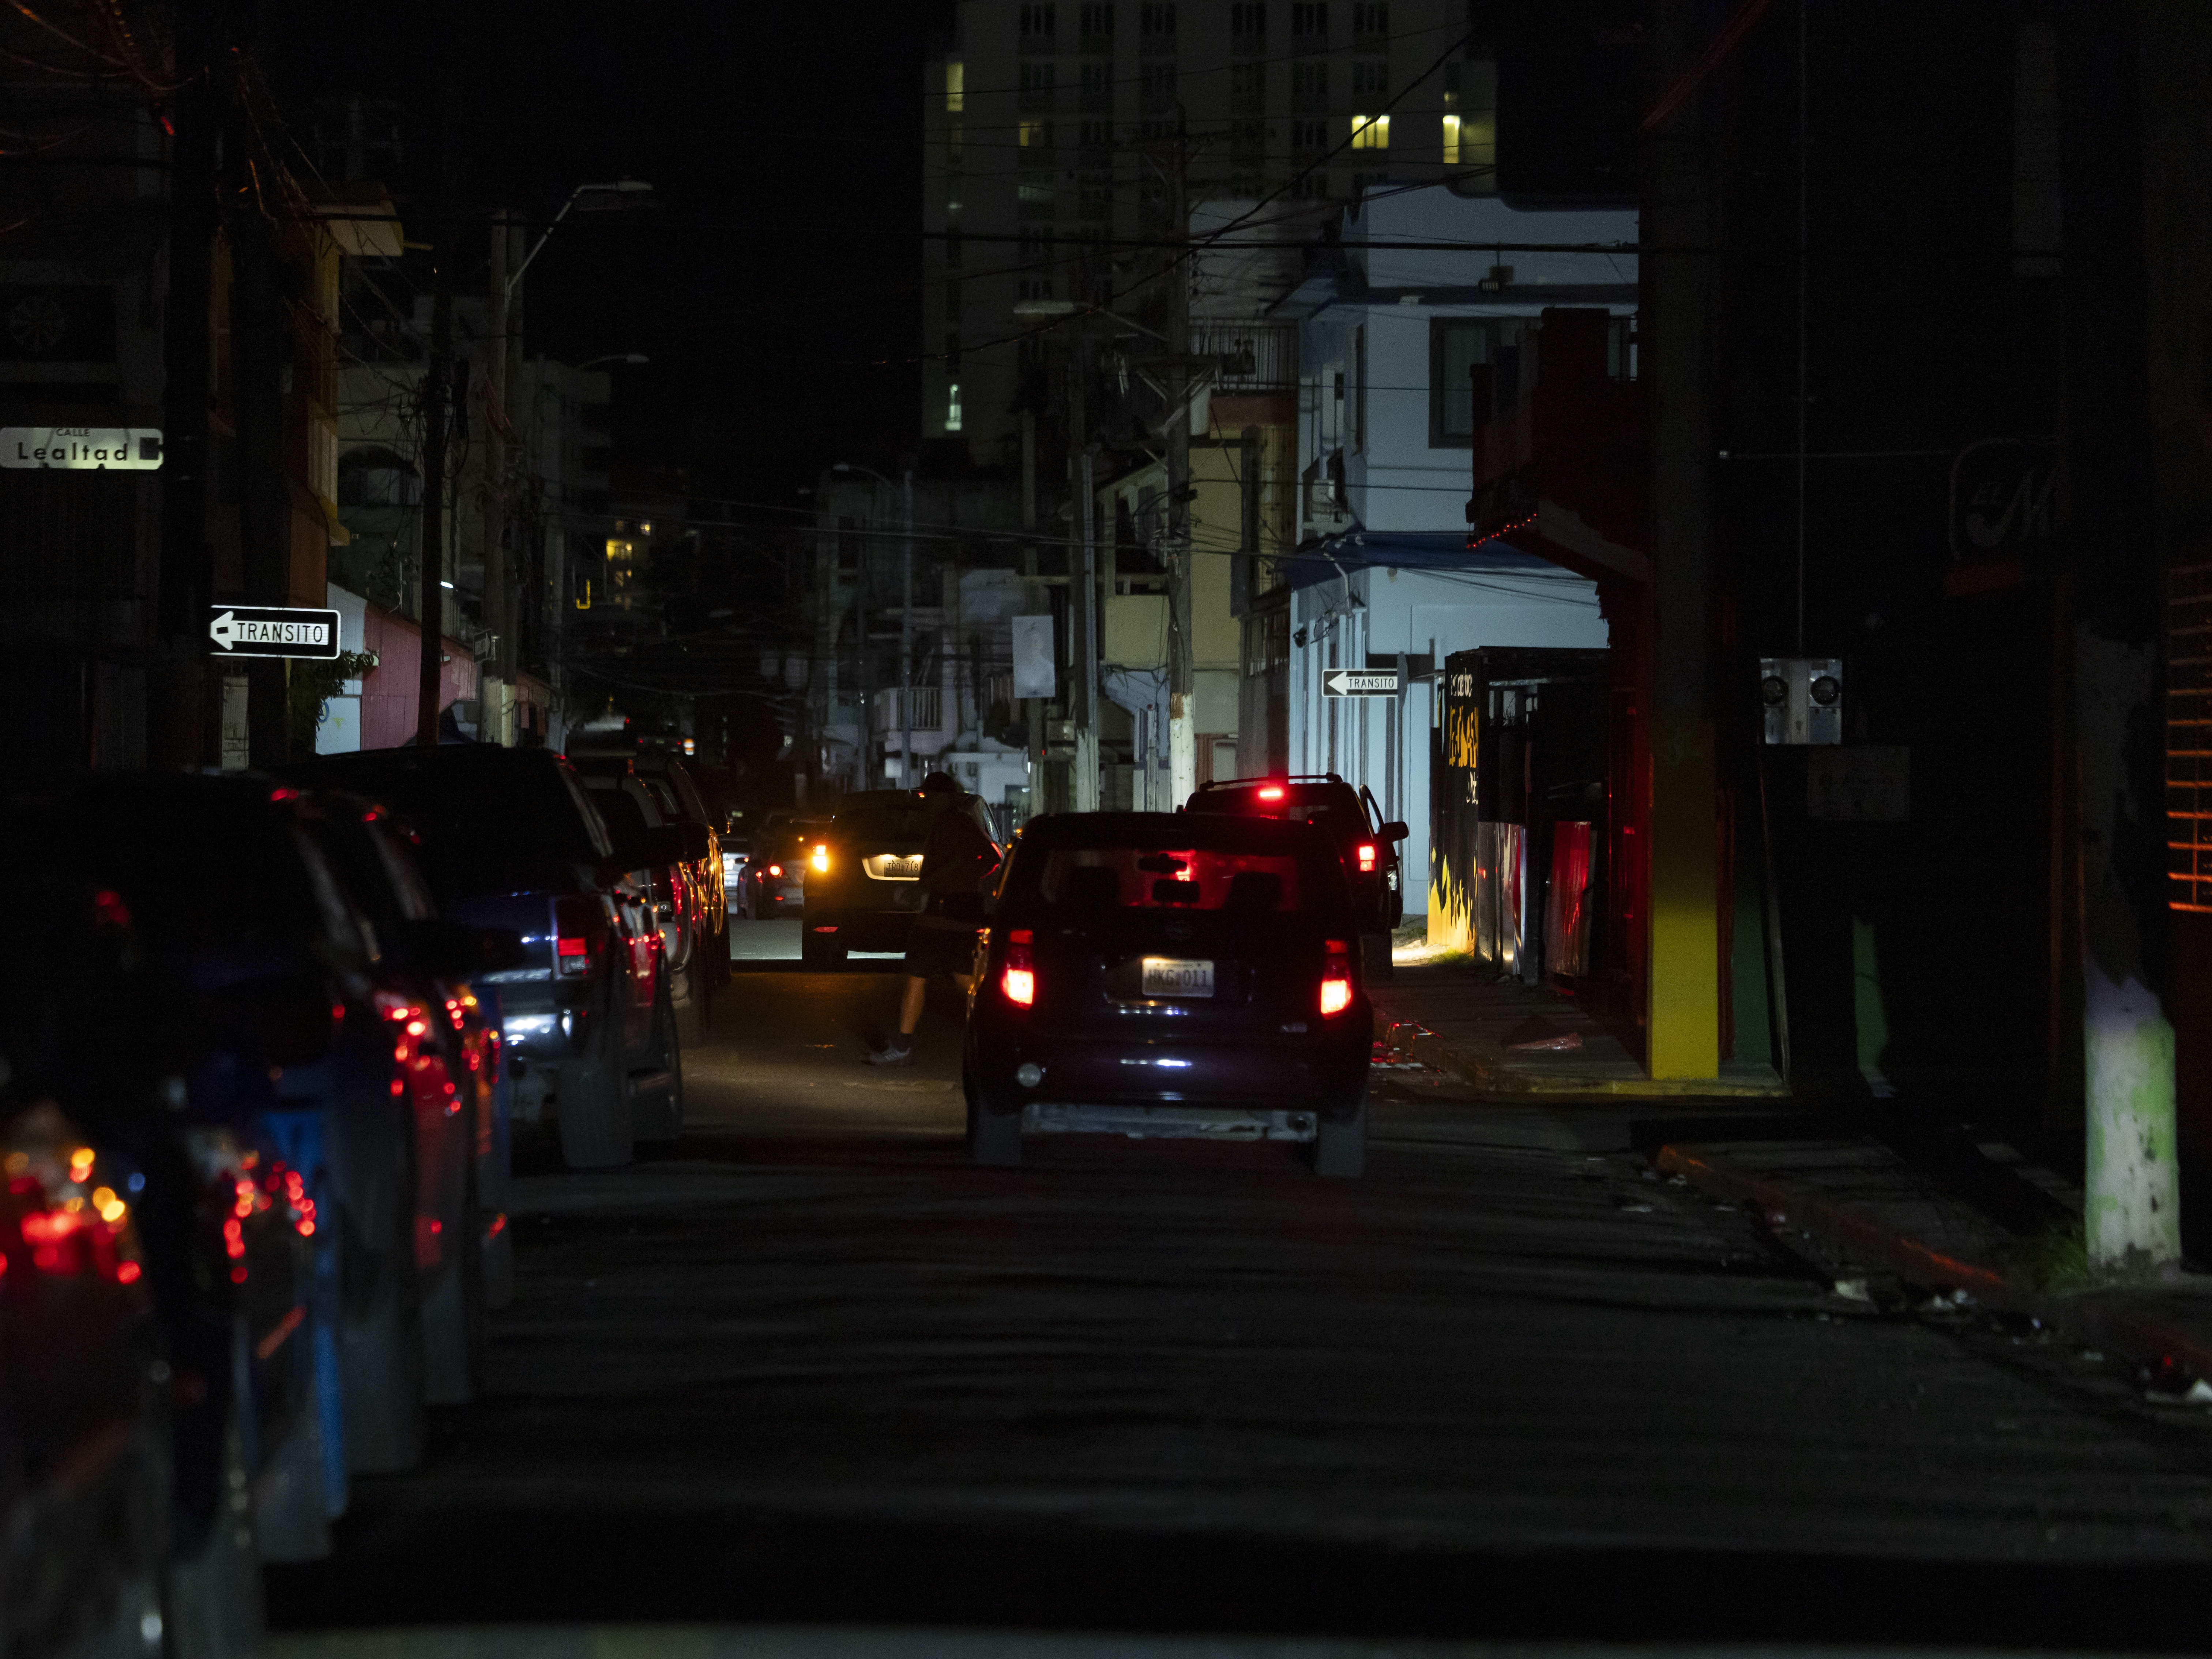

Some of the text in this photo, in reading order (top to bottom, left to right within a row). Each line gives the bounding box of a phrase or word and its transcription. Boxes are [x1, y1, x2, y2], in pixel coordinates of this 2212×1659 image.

[56, 429, 90, 437] CALLE
[18, 442, 128, 461] Lealtad
[237, 622, 323, 643] TRANSITO
[1348, 678, 1394, 688] TRANSITO
[905, 863, 918, 872] 718
